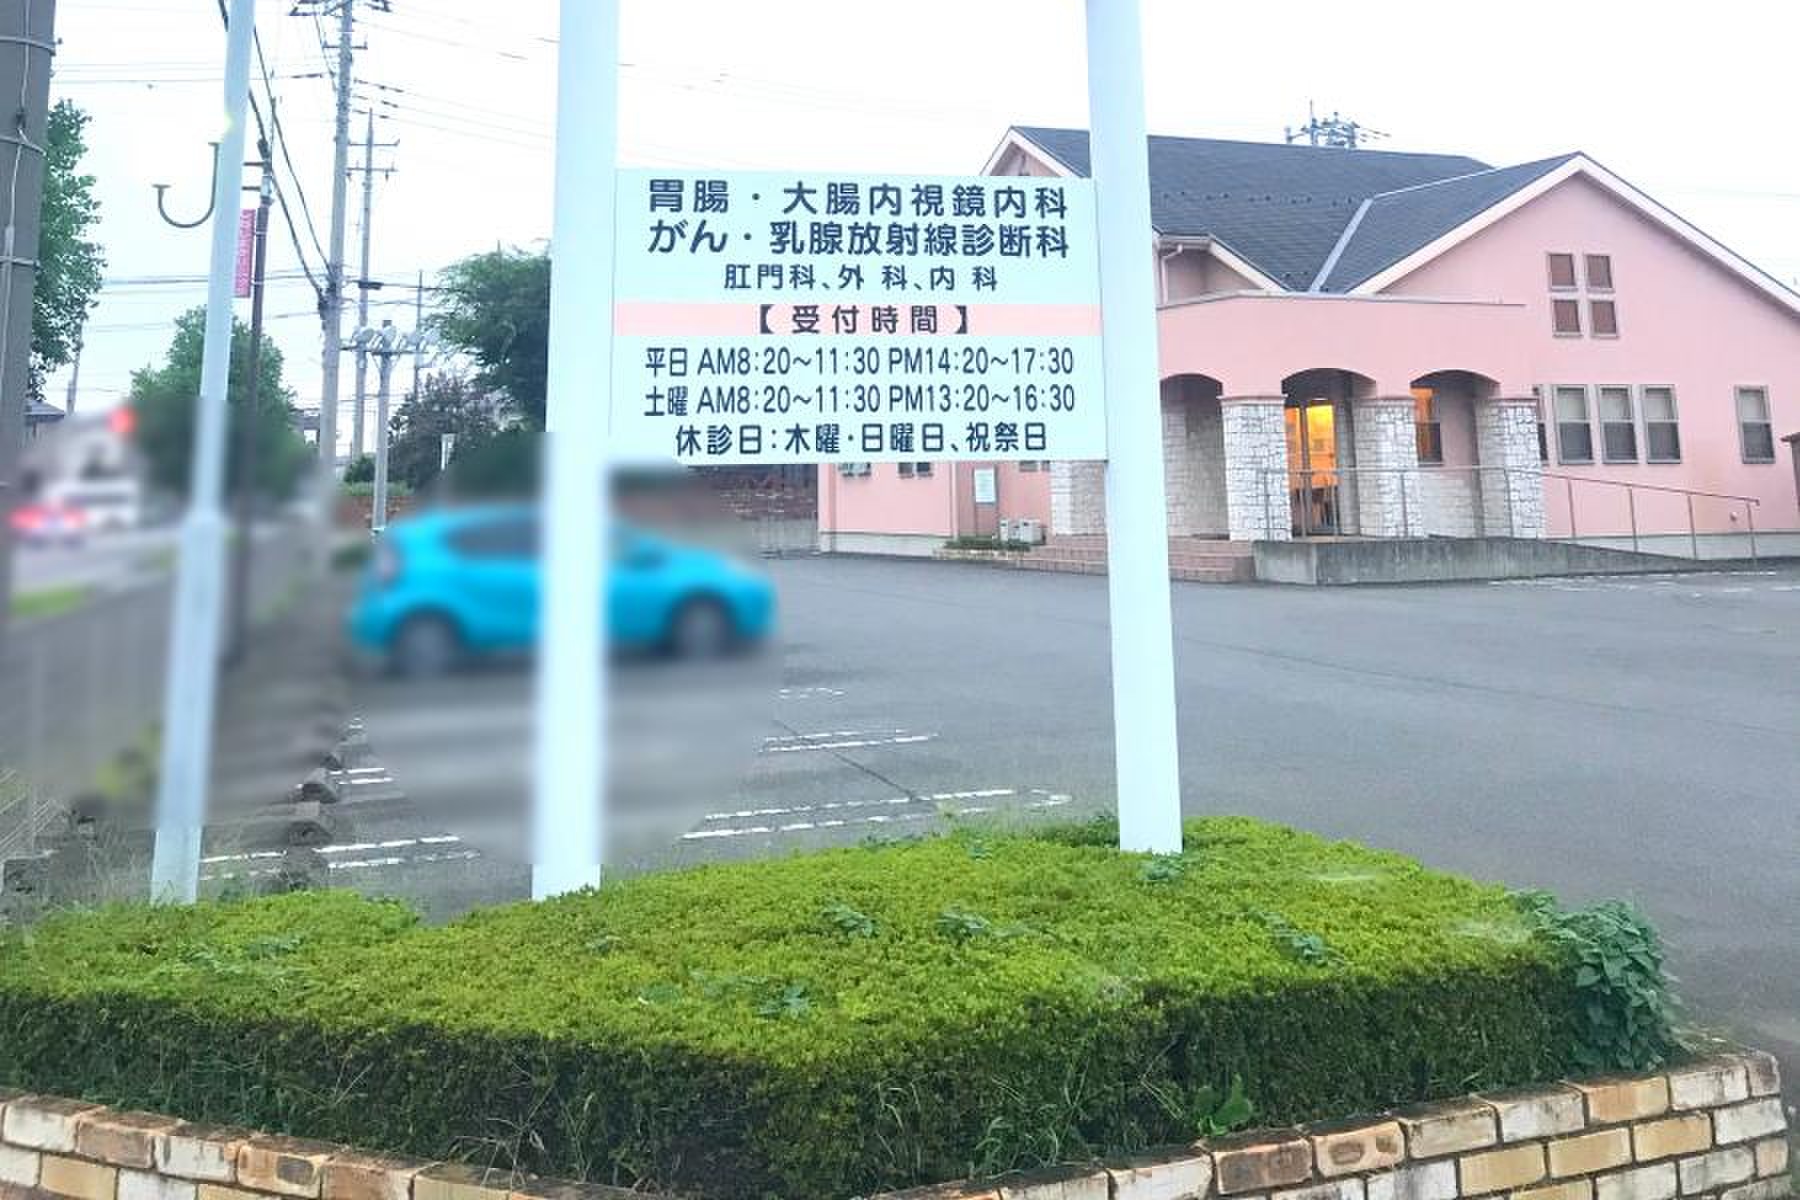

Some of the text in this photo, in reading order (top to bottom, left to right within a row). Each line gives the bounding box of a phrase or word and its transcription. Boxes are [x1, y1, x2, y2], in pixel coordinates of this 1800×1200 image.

[648, 178, 1068, 220] 胃腸・大腸内視鏡内科
[647, 218, 1069, 258] がん・乳腺放射線診断科
[644, 347, 688, 378] 平日
[643, 386, 689, 417] 土曜
